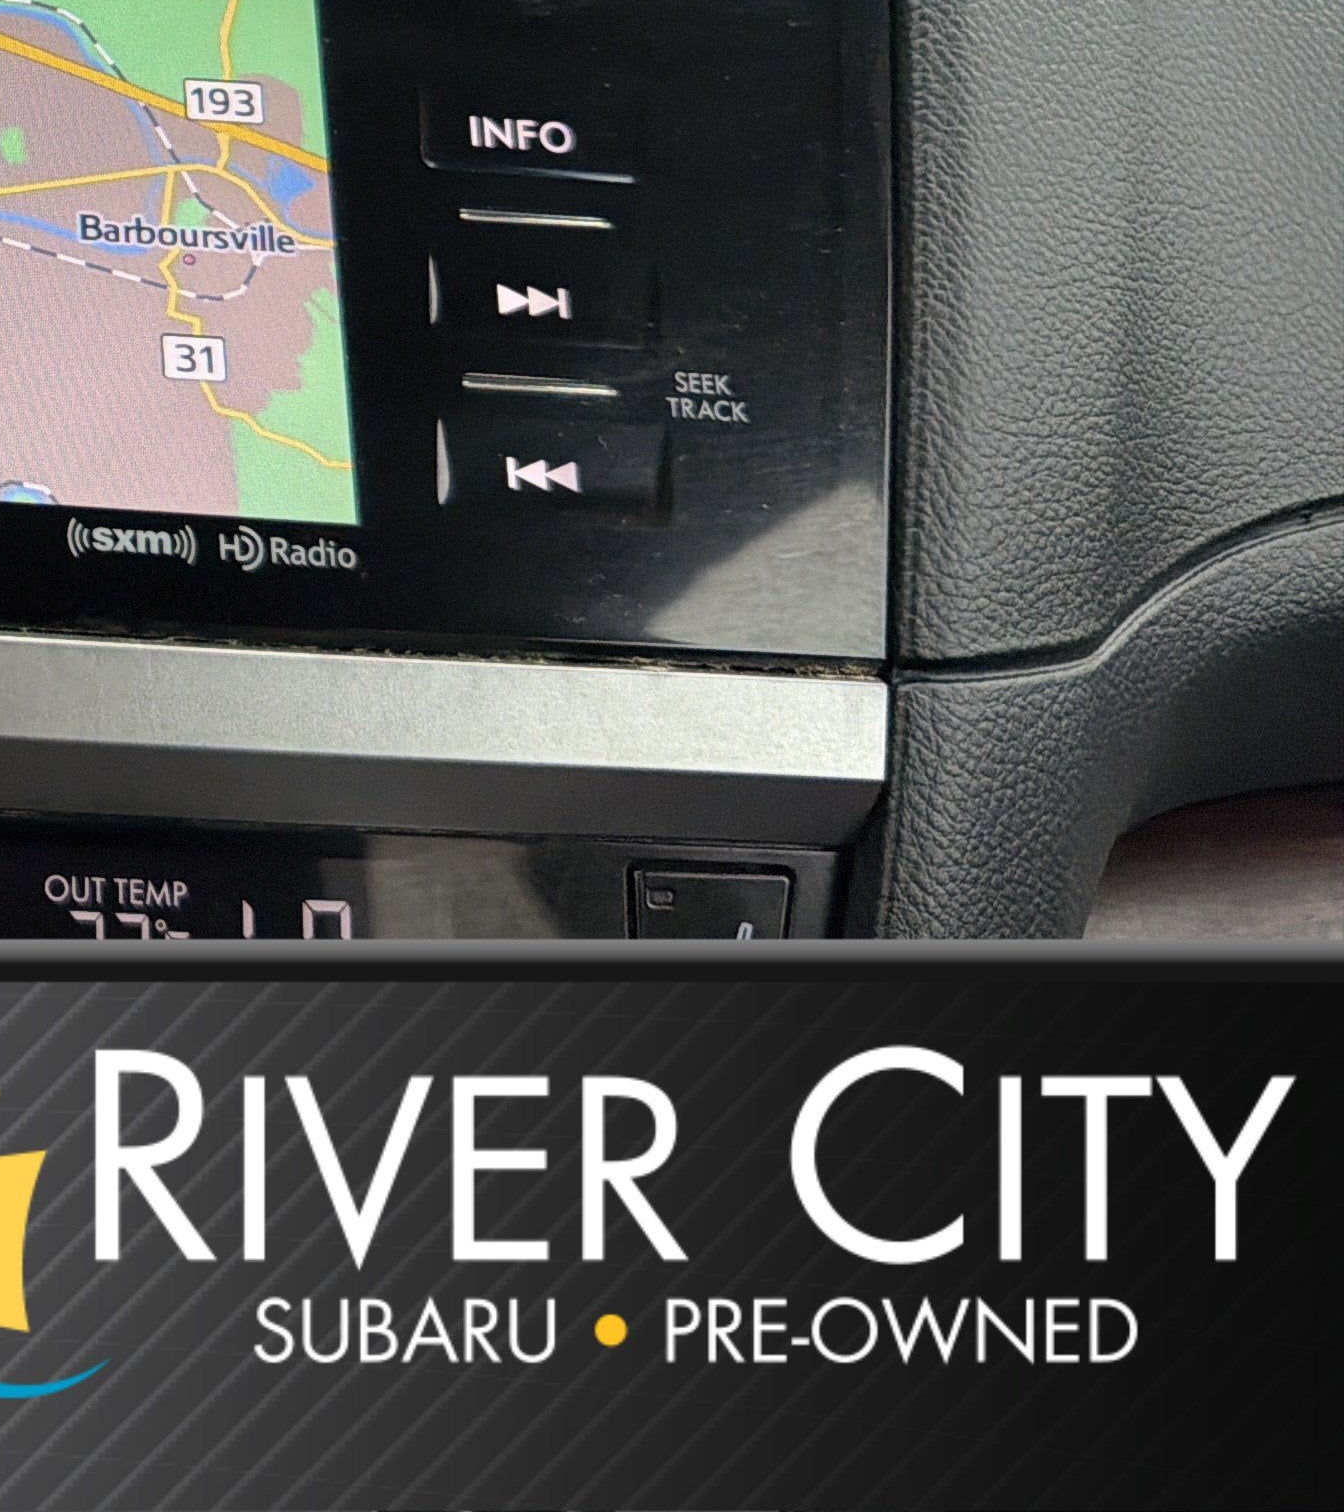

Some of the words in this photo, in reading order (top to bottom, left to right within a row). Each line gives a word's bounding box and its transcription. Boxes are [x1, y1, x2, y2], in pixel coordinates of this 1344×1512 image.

[190, 87, 256, 118] 193
[469, 115, 578, 154] INFO
[79, 214, 296, 255] Barboursville
[174, 343, 217, 374] 31
[674, 372, 732, 396] SEEK
[665, 397, 750, 424] TRACK
[91, 526, 173, 556] sxm
[270, 537, 358, 569] Radio
[44, 874, 107, 904] OUT
[113, 877, 189, 908] TEMP
